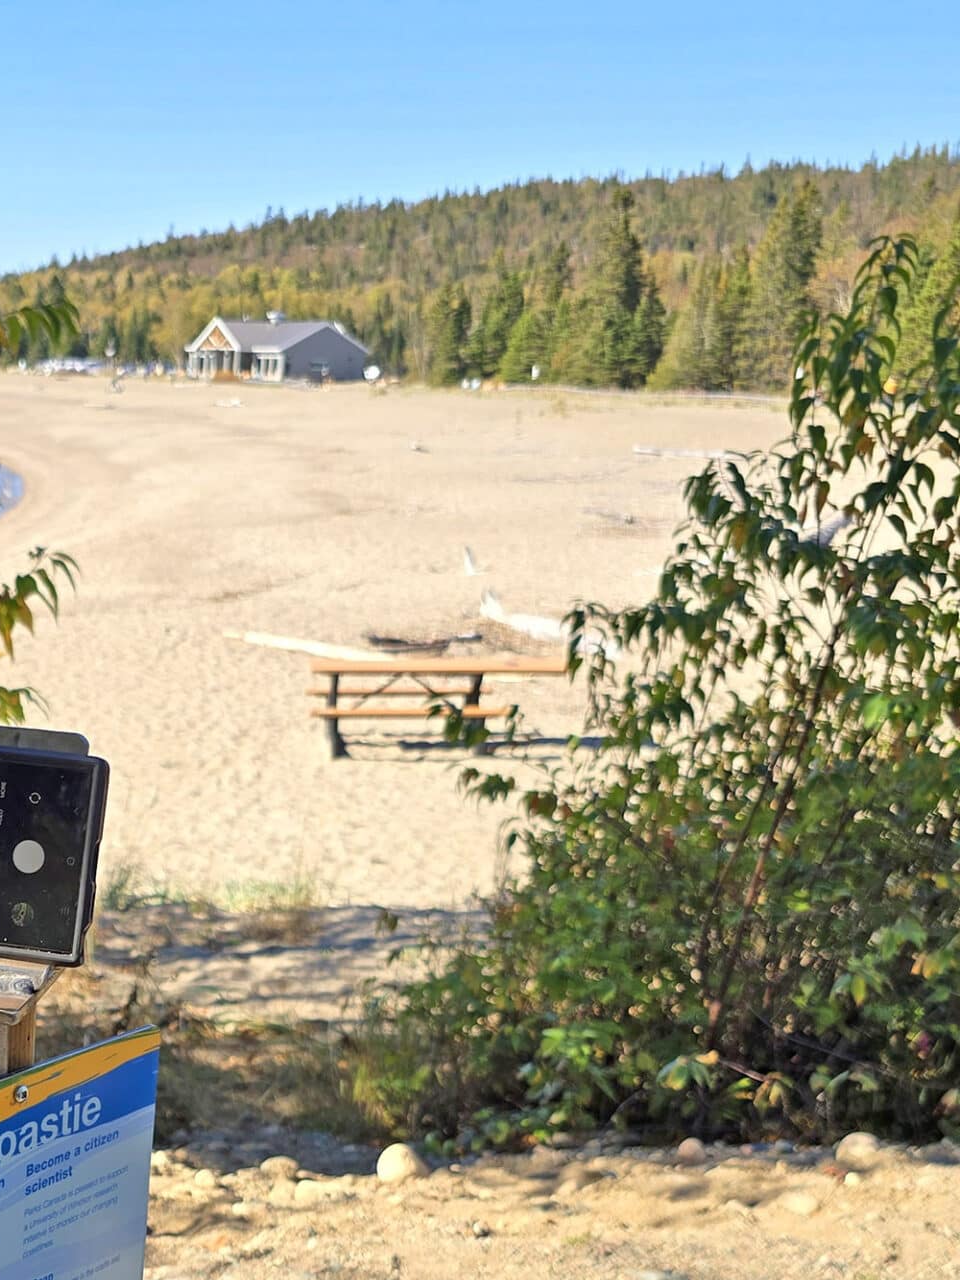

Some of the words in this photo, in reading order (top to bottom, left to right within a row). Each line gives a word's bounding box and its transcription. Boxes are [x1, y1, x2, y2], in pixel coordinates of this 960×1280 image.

[26, 1151, 71, 1178] Become
[74, 1146, 81, 1157] a
[84, 1130, 119, 1152] citizen
[25, 1165, 73, 1196] scientist
